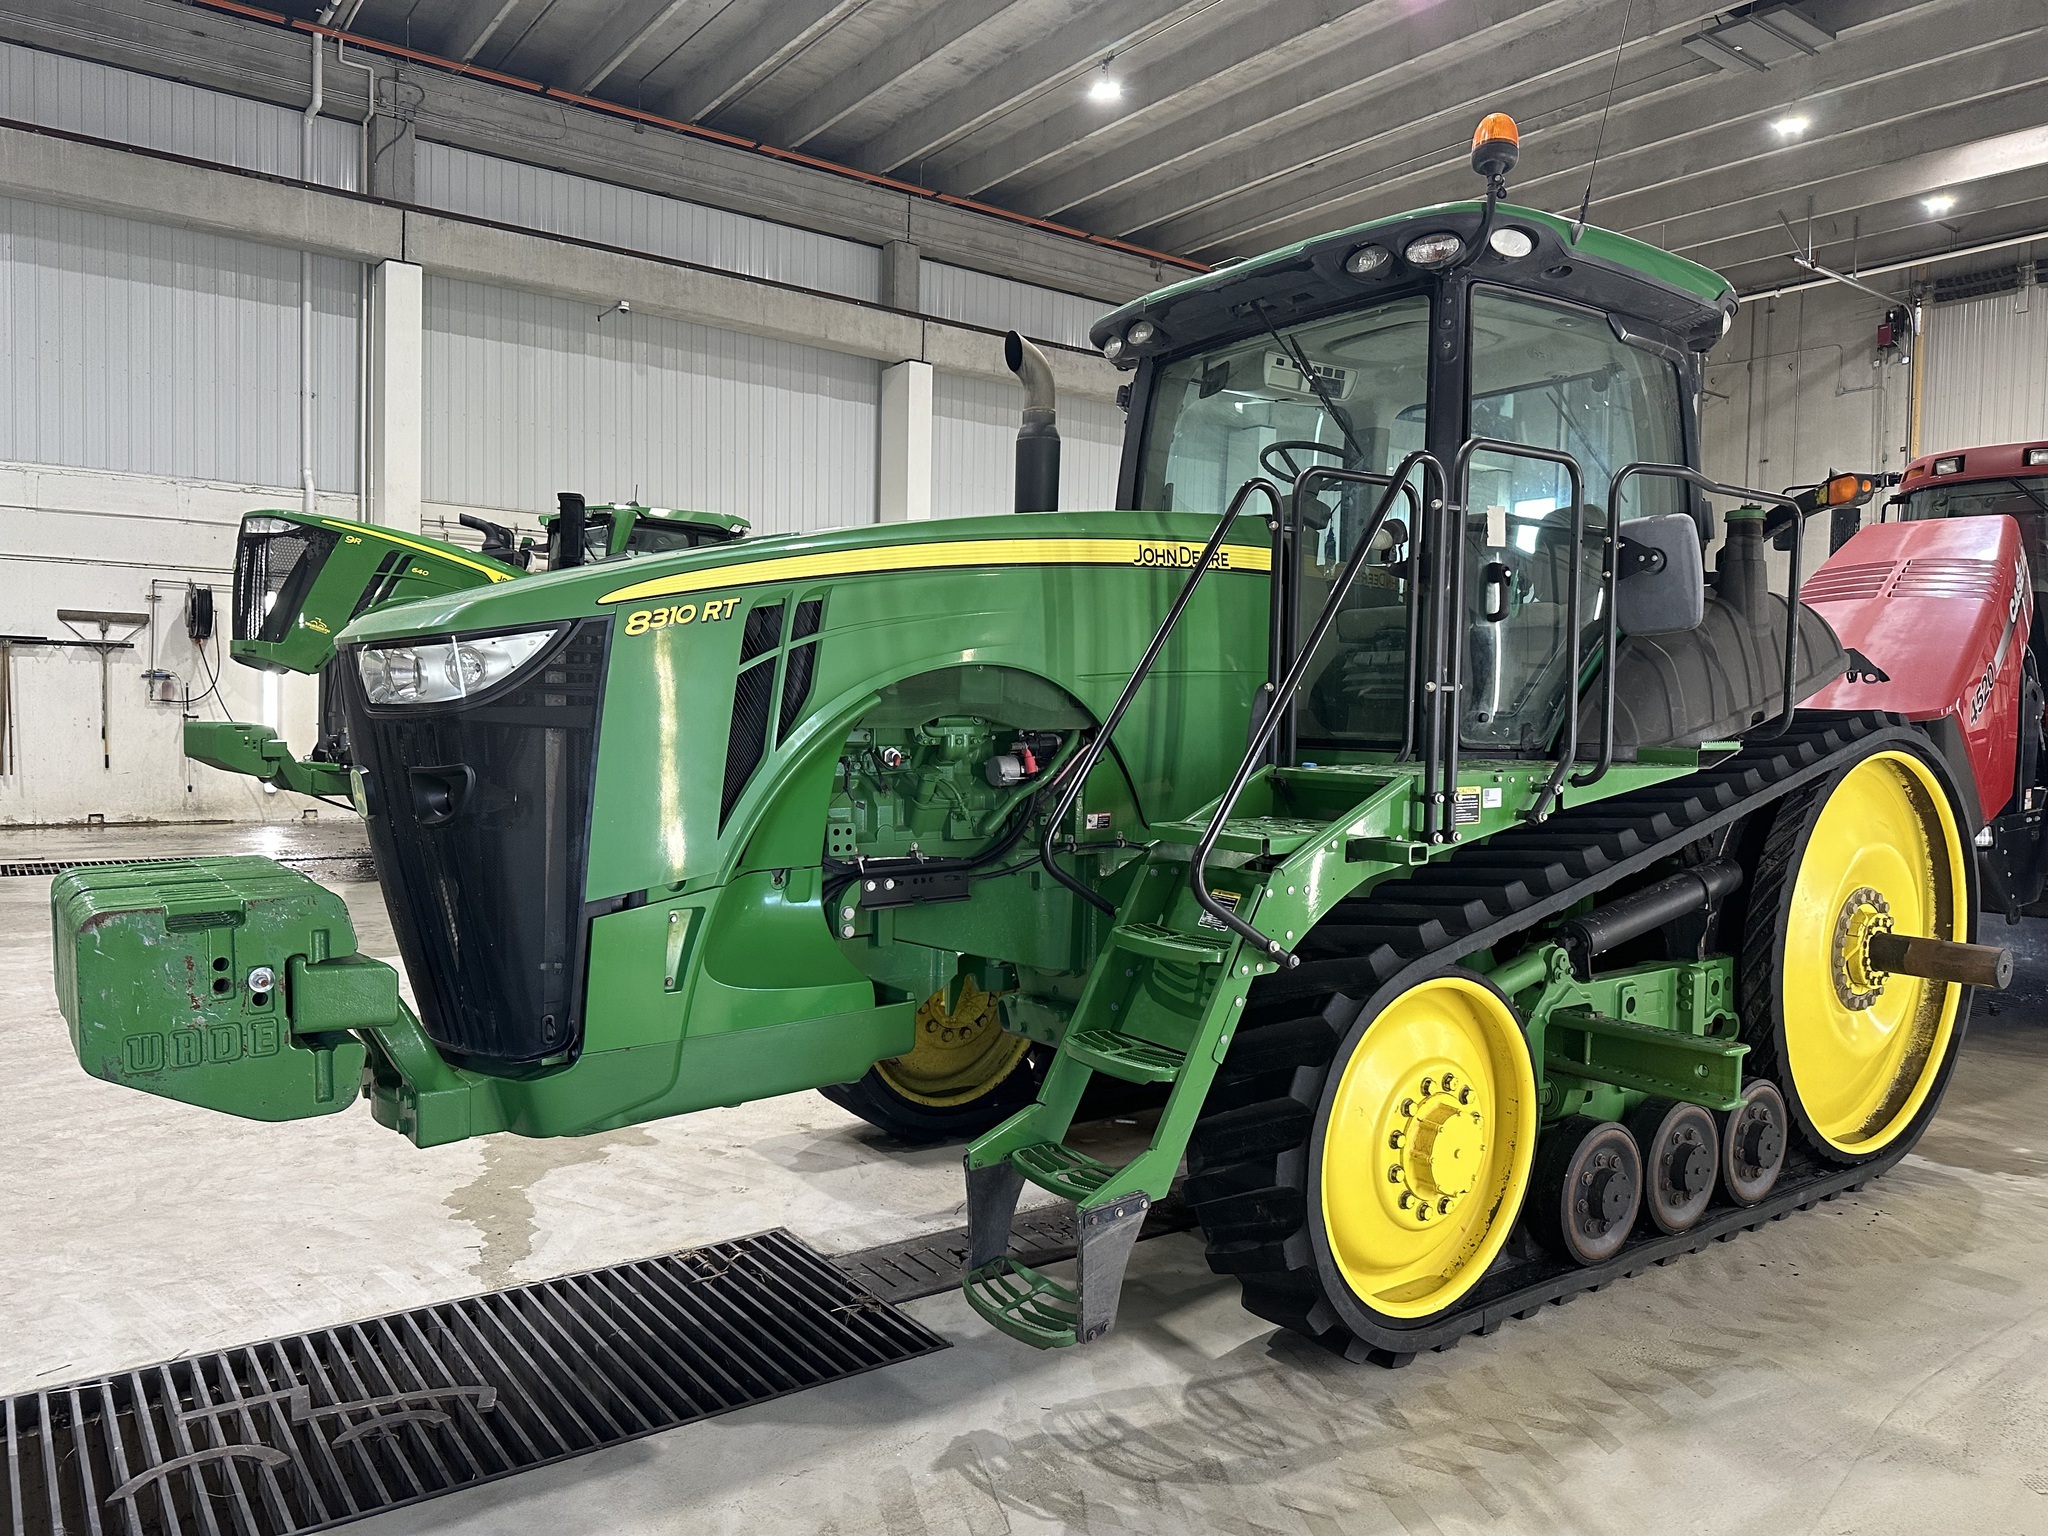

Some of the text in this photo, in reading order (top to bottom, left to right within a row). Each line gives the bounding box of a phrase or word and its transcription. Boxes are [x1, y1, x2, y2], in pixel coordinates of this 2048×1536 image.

[345, 535, 362, 545] 9R
[1133, 544, 1230, 567] JOHN DERE
[411, 567, 429, 576] 640
[624, 597, 742, 636] 8310 RT
[1970, 662, 1995, 725] 4520
[126, 1020, 277, 1071] WADE
